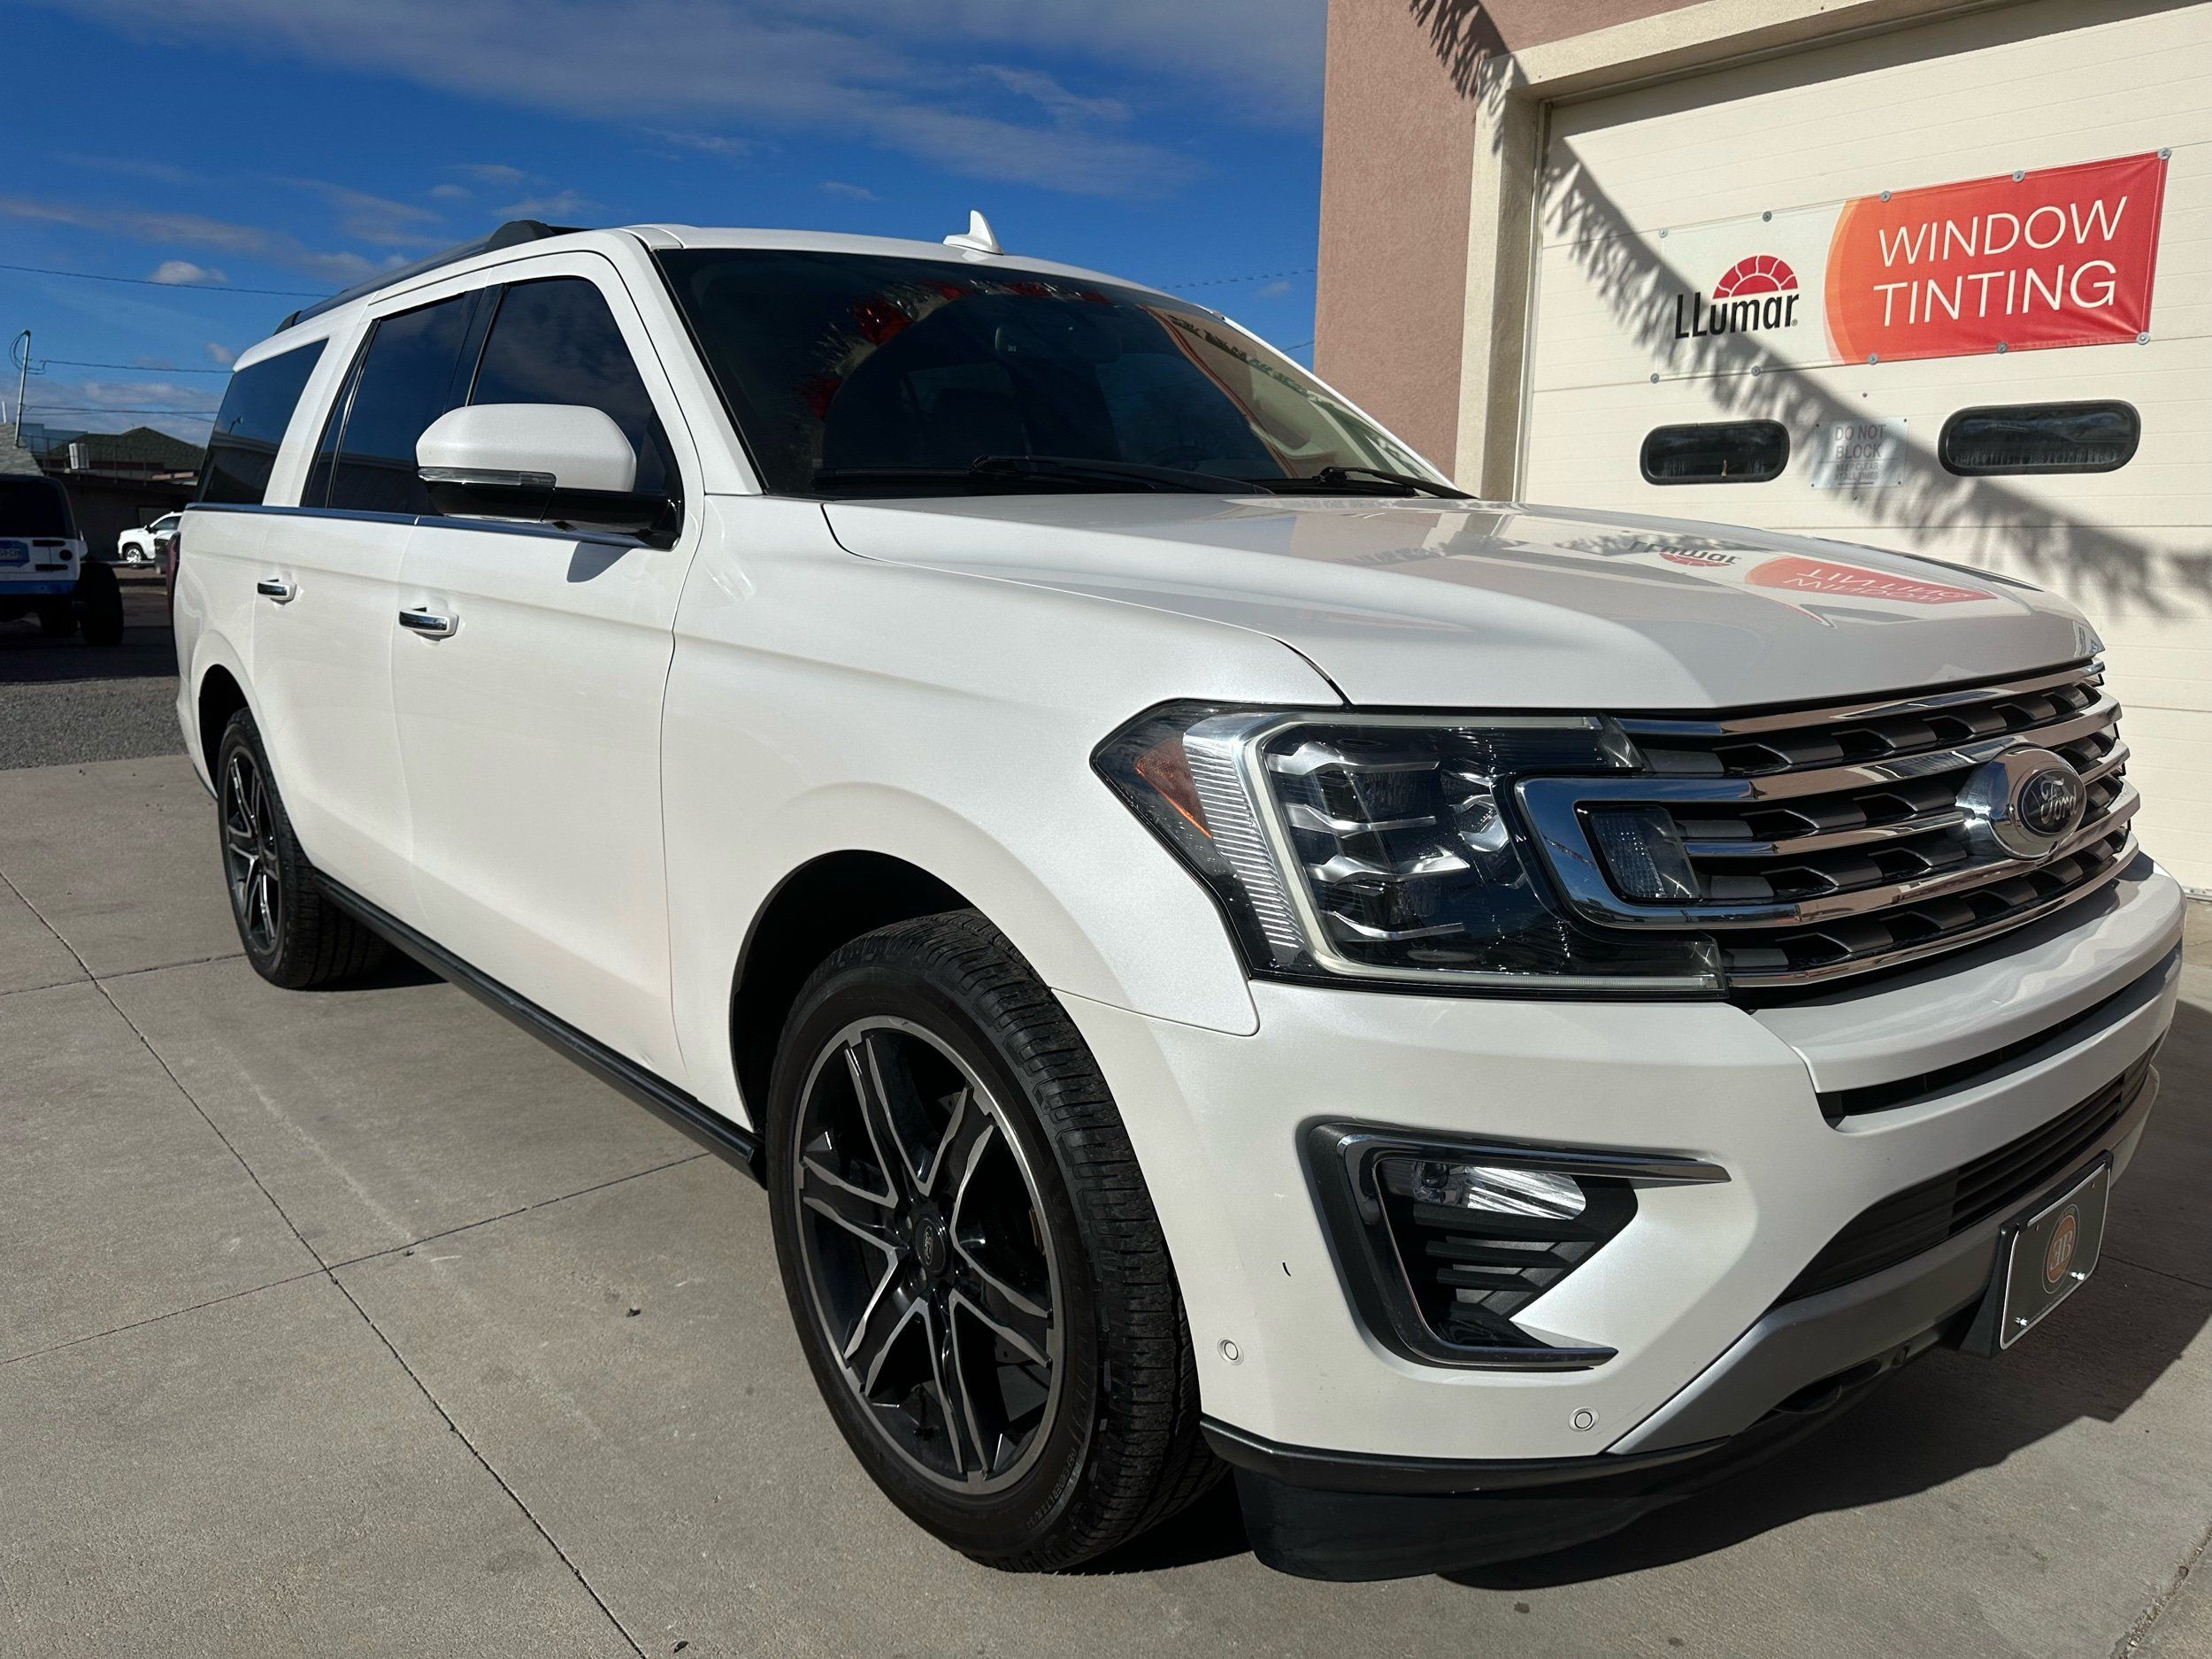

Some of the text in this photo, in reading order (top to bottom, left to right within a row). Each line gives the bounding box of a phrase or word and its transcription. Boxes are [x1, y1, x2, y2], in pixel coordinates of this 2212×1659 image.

[1878, 196, 2128, 267] WINDOW
[1674, 293, 1800, 340] LLumar
[1873, 259, 2117, 327] TINTING
[1836, 424, 1886, 441] DO NOT
[1836, 443, 1882, 458] BLOCK
[2039, 777, 2078, 824] Ford
